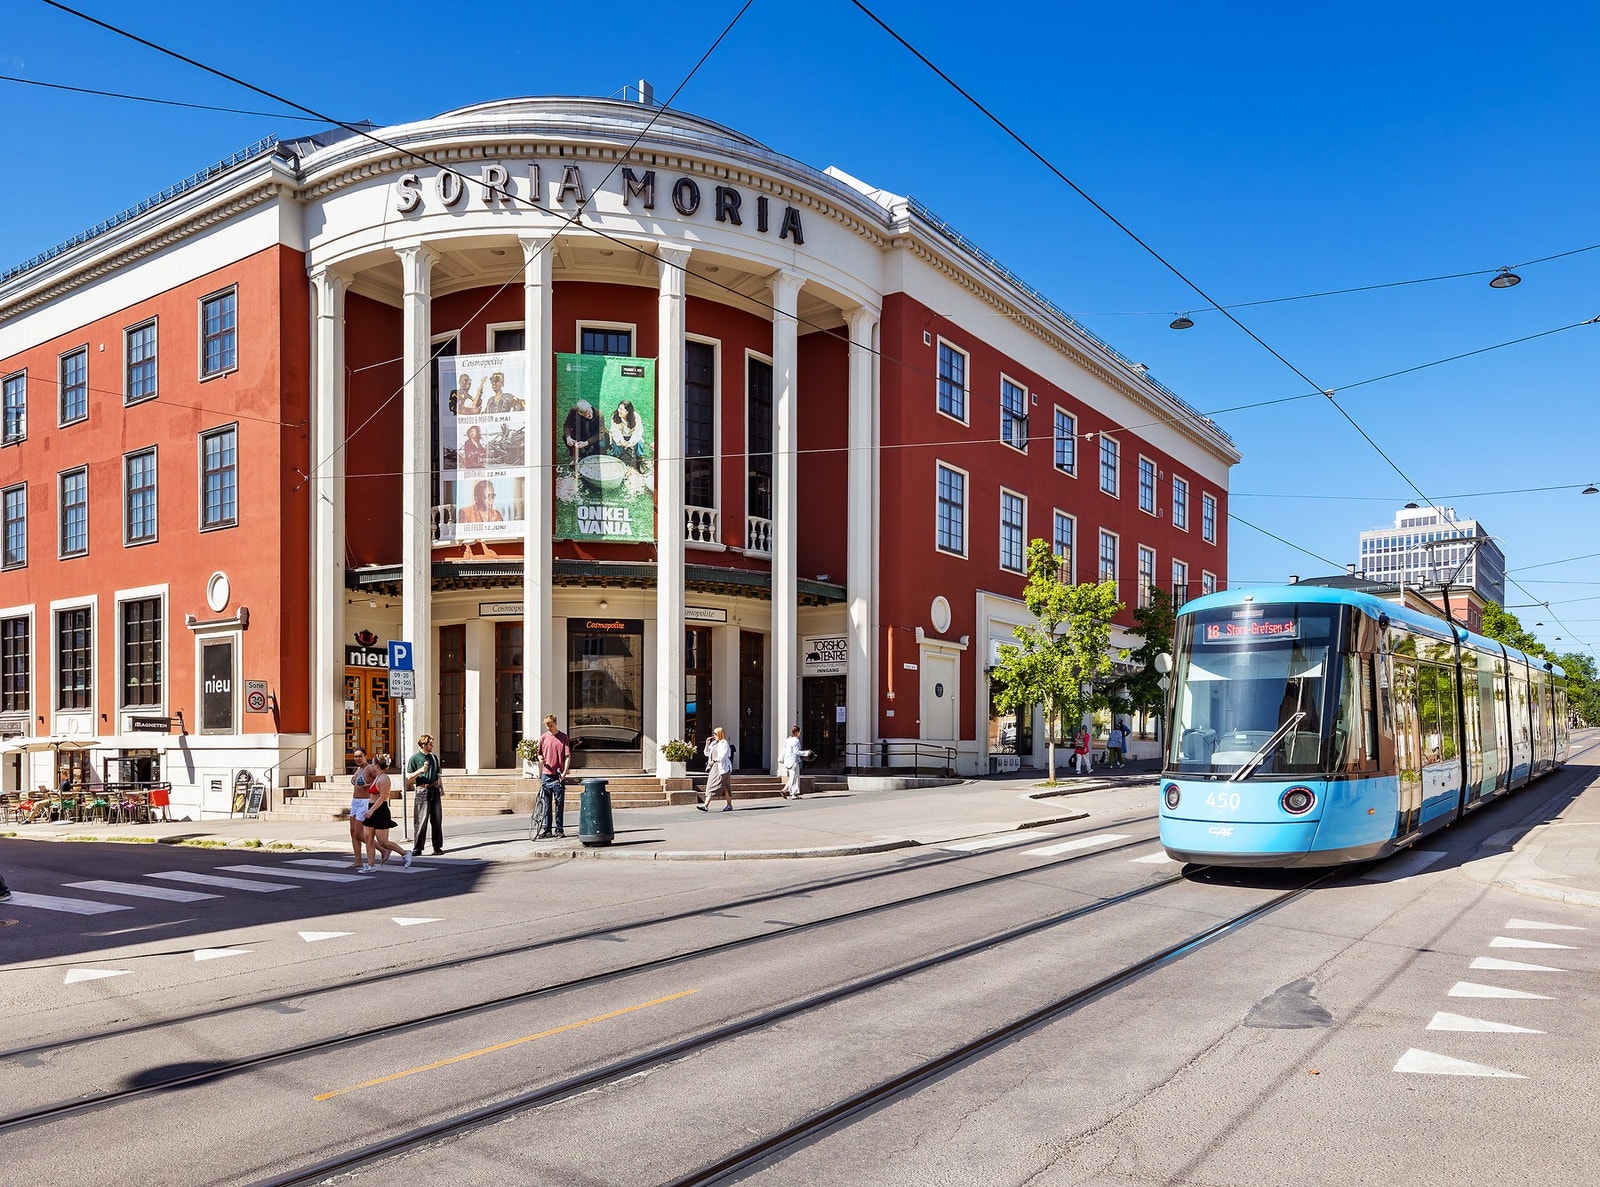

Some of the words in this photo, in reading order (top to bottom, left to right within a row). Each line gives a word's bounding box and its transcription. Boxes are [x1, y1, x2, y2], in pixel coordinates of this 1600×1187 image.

[397, 164, 586, 213] SORIA
[622, 168, 804, 245] MORIA
[462, 357, 504, 368] Cosmopolite
[577, 506, 632, 521] ONKEL
[578, 520, 632, 535] VANJA
[492, 604, 524, 613] Cosmopo
[685, 609, 715, 617] mopolite
[586, 621, 625, 631] Cosmopolite
[1207, 624, 1220, 639] 18
[350, 647, 388, 667] nieu
[394, 644, 407, 667] P
[205, 674, 230, 693] nieu
[251, 696, 262, 706] 30
[1206, 792, 1241, 809] 450
